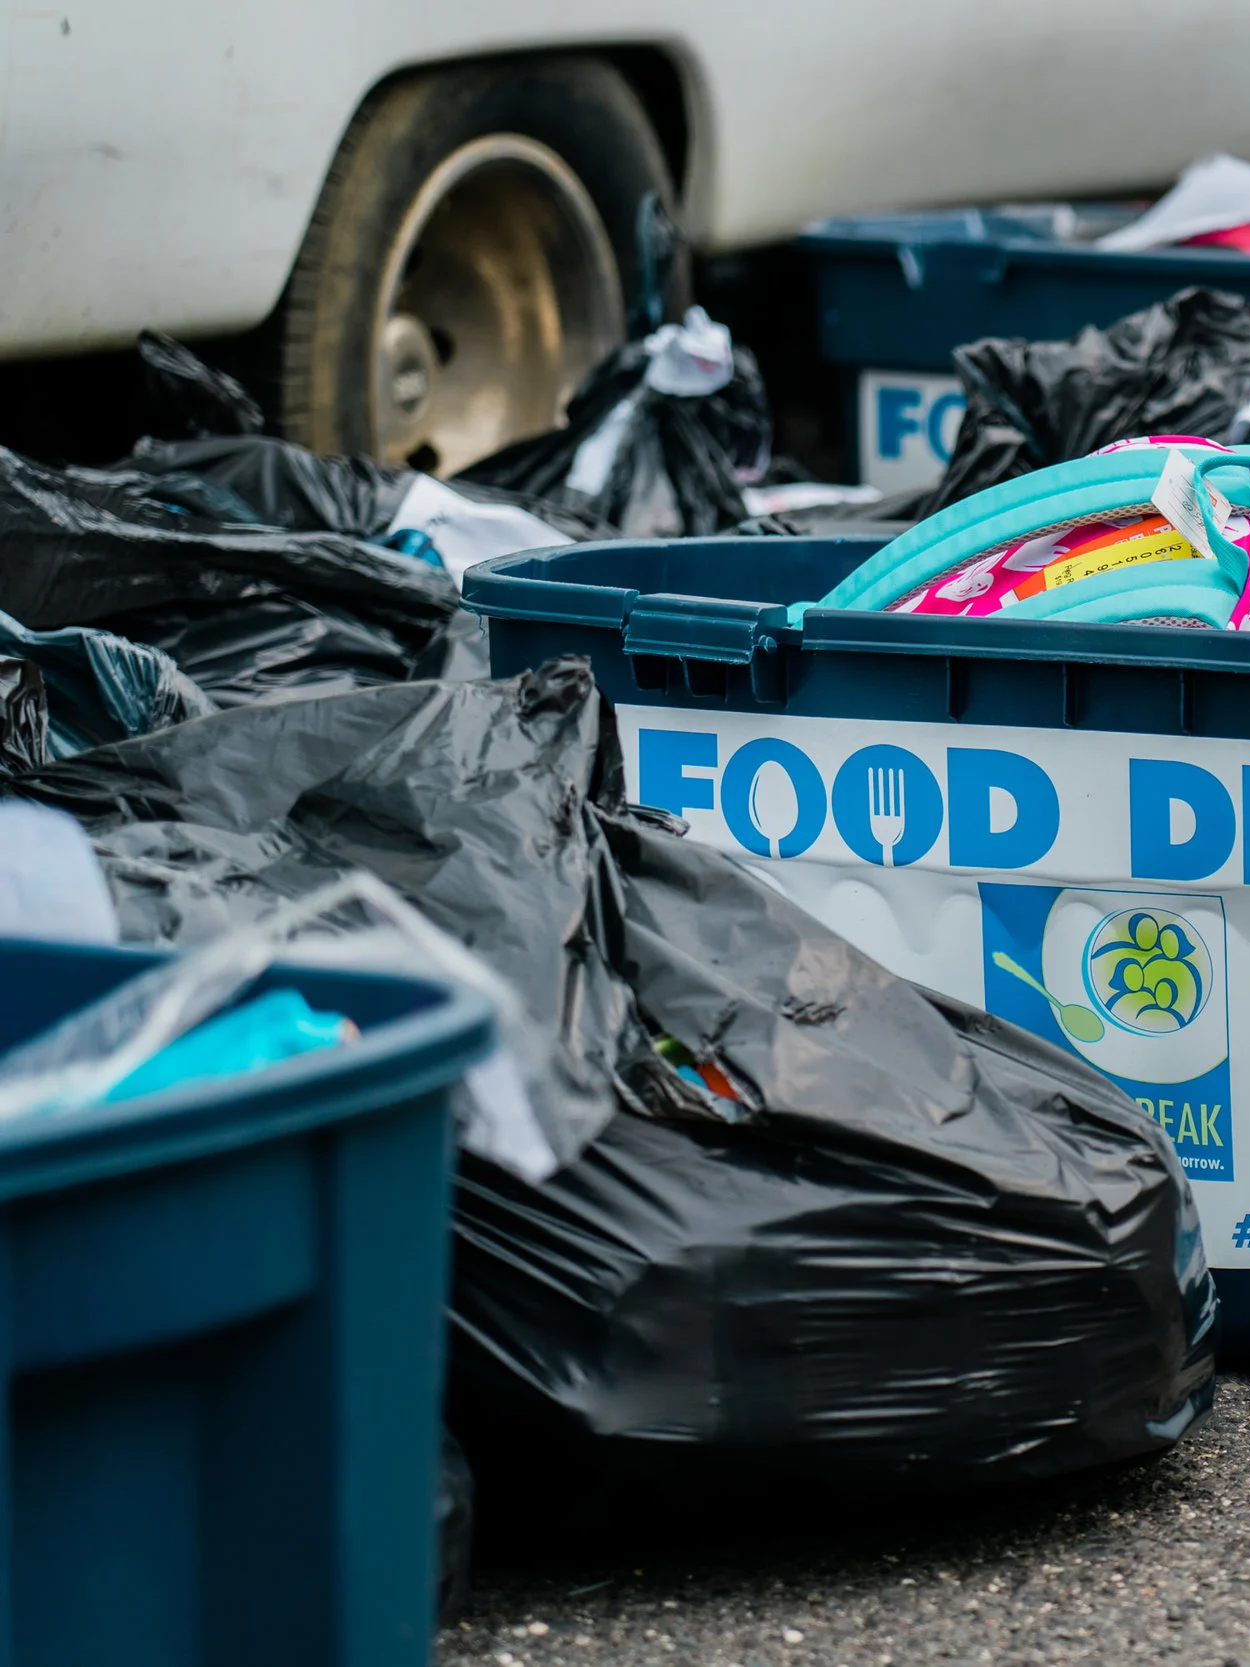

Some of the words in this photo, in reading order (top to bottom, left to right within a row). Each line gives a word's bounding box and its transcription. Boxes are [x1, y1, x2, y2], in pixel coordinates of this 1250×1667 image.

[878, 386, 969, 464] FO
[638, 727, 1061, 870] FOOD
[1135, 1097, 1225, 1147] EAK
[1178, 1156, 1225, 1170] orrow.
